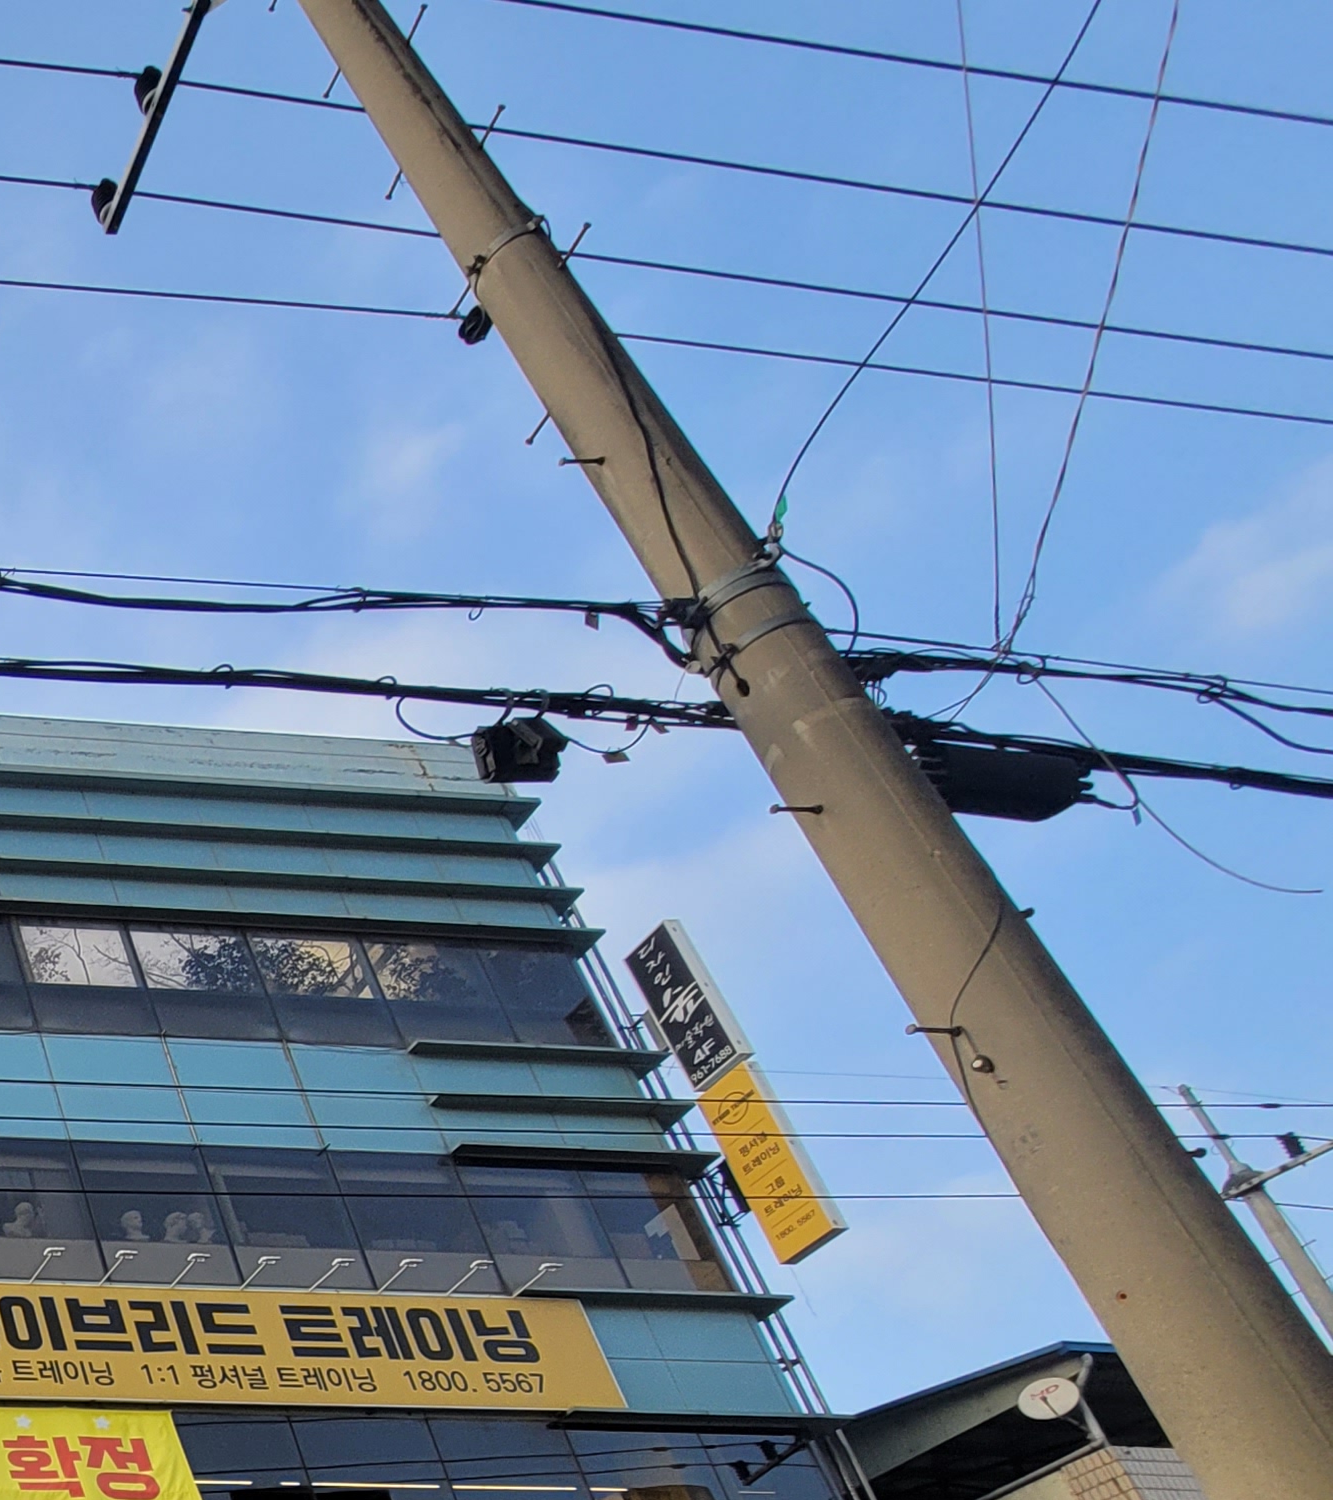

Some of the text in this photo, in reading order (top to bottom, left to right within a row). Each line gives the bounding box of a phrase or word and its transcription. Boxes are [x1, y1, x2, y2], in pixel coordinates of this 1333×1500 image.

[690, 1045, 734, 1085] 961-7688
[692, 1038, 717, 1065] 4F
[277, 1300, 542, 1365] 트레이닝
[11, 1357, 117, 1388] 트레이닝
[138, 1363, 182, 1389] 1:1
[190, 1364, 267, 1393] 펑셔널
[274, 1365, 379, 1394] 트레이닝
